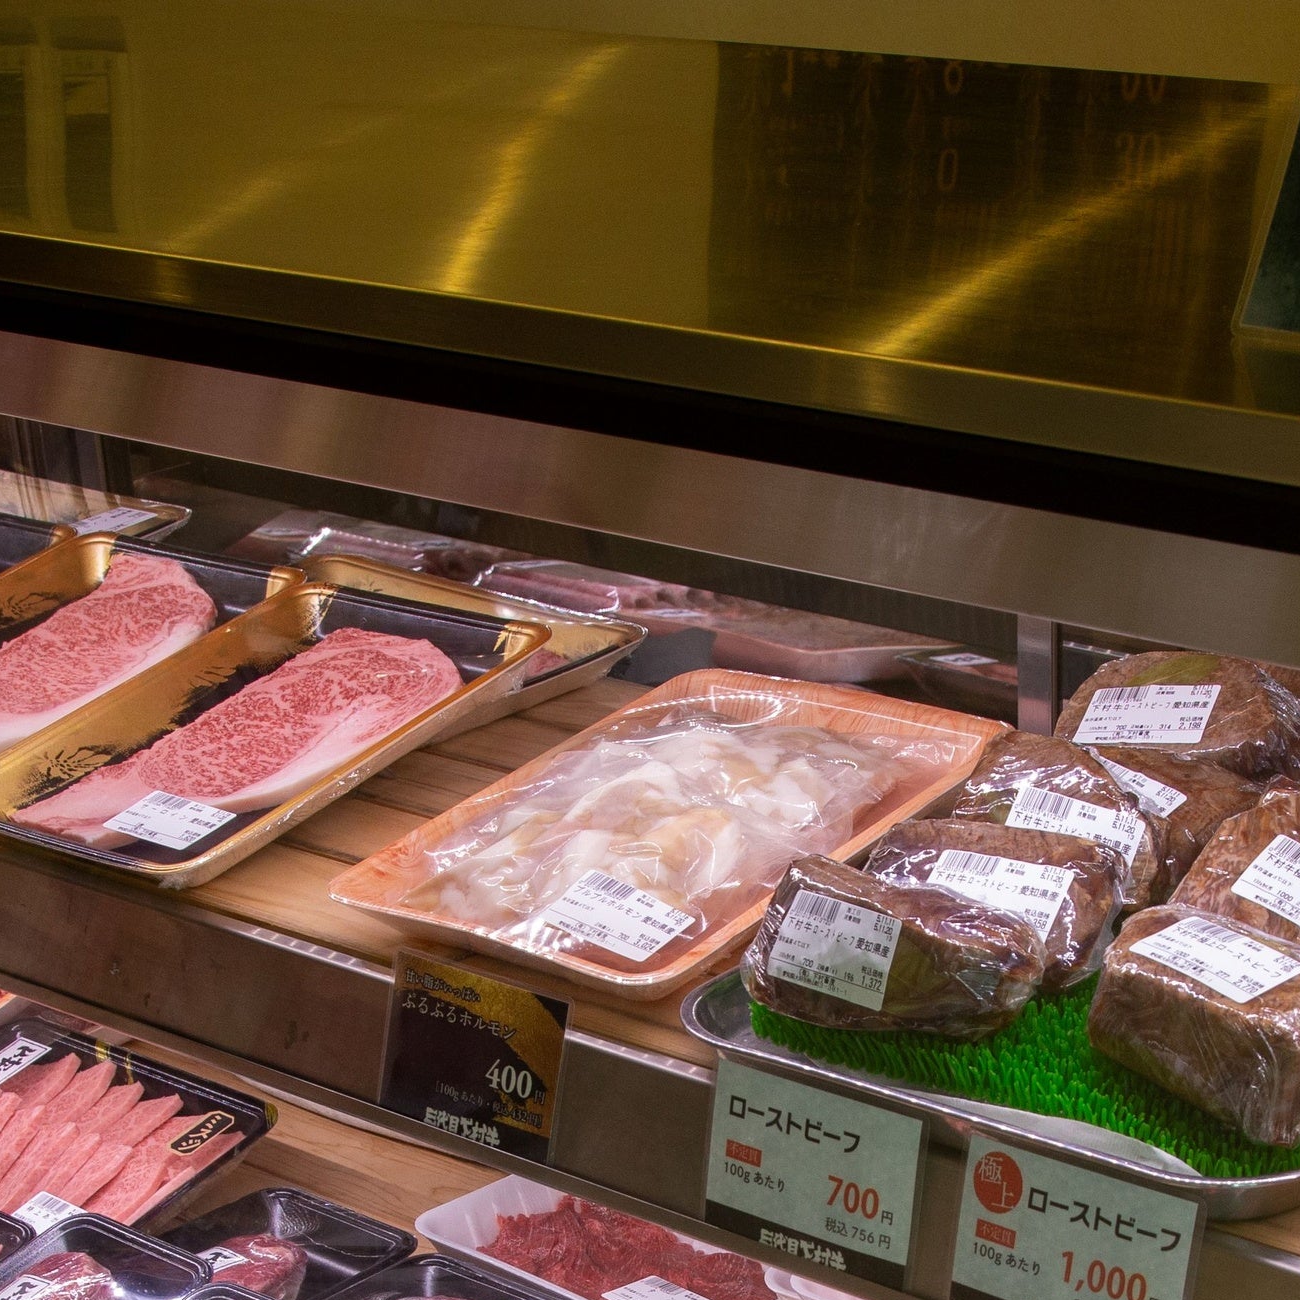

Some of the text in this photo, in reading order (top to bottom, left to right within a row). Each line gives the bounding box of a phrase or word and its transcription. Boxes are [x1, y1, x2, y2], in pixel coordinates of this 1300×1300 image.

[1178, 722, 1201, 730] 2,198
[1112, 822, 1135, 835] 5.11.20
[1020, 885, 1059, 901] 愛知県産
[1040, 873, 1064, 883] 5.11.20
[574, 886, 642, 919] プルプルホルモン
[641, 916, 676, 935] 愛知県産
[1277, 890, 1294, 902] 1000
[873, 925, 893, 935] 5.11.20
[855, 937, 890, 958] 愛知県産
[405, 968, 481, 1002] 甘い脂がいっぱい
[861, 976, 882, 991] 1,372
[485, 1059, 533, 1098] 400
[729, 1095, 861, 1153] ローストビーフ
[723, 1161, 785, 1193] 100g あたり
[978, 1156, 1015, 1210] 極上
[827, 1175, 894, 1226] 700 円
[825, 1217, 891, 1250] 税込 756 円
[1028, 1186, 1182, 1252] ローストビーフ
[973, 1242, 1041, 1276] 100g あたり
